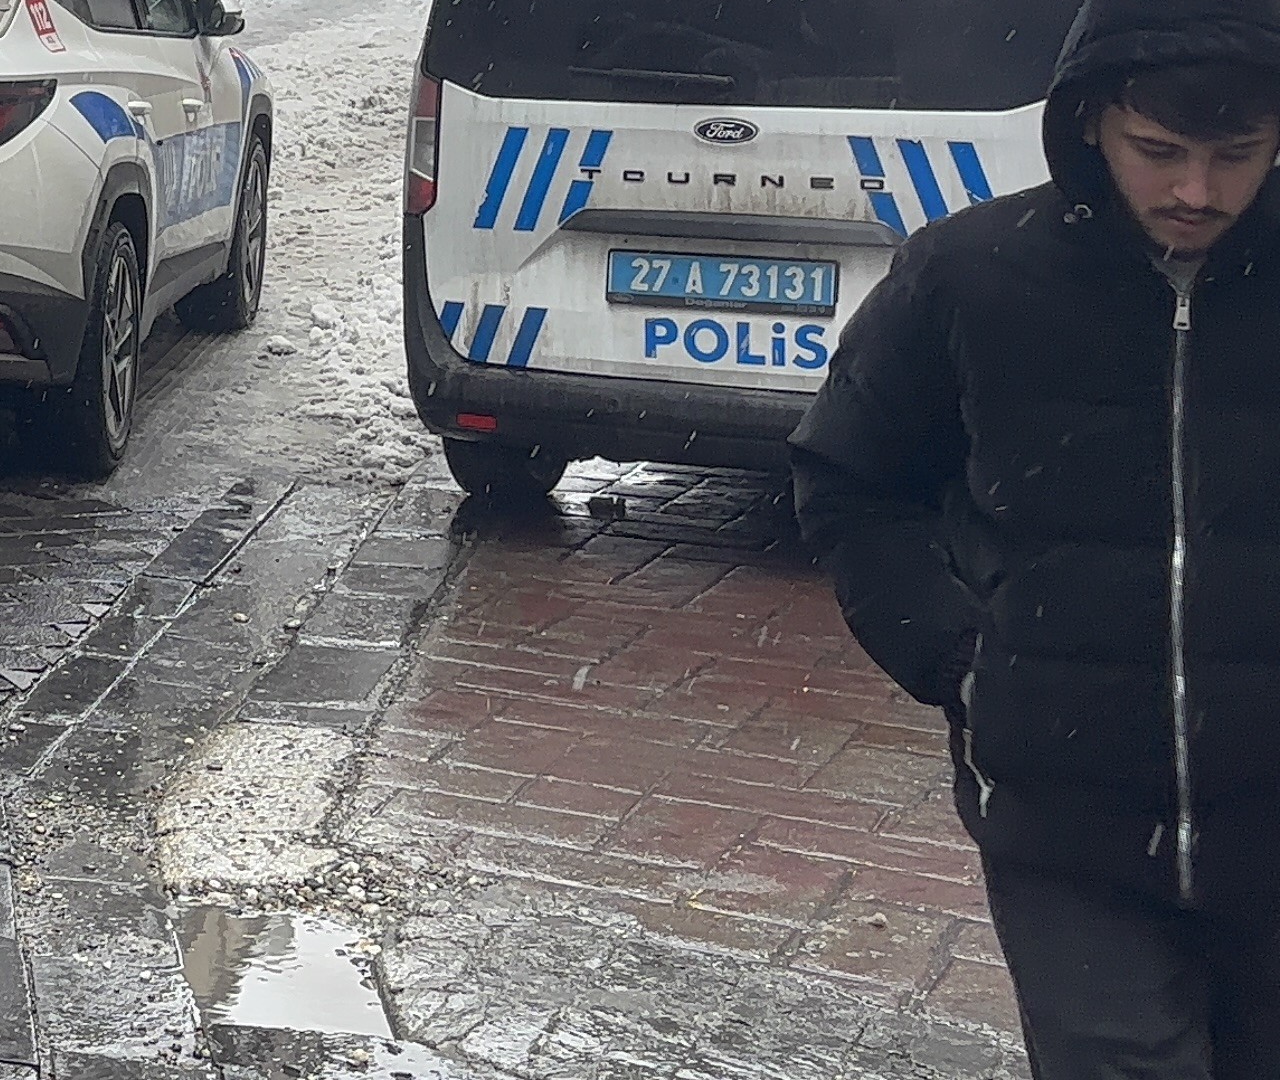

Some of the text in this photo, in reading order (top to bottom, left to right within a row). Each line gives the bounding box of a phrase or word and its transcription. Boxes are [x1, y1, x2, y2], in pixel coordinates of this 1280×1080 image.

[705, 122, 745, 139] Ford
[580, 167, 886, 192] TOURNEO
[629, 257, 827, 303] 27 A 73131
